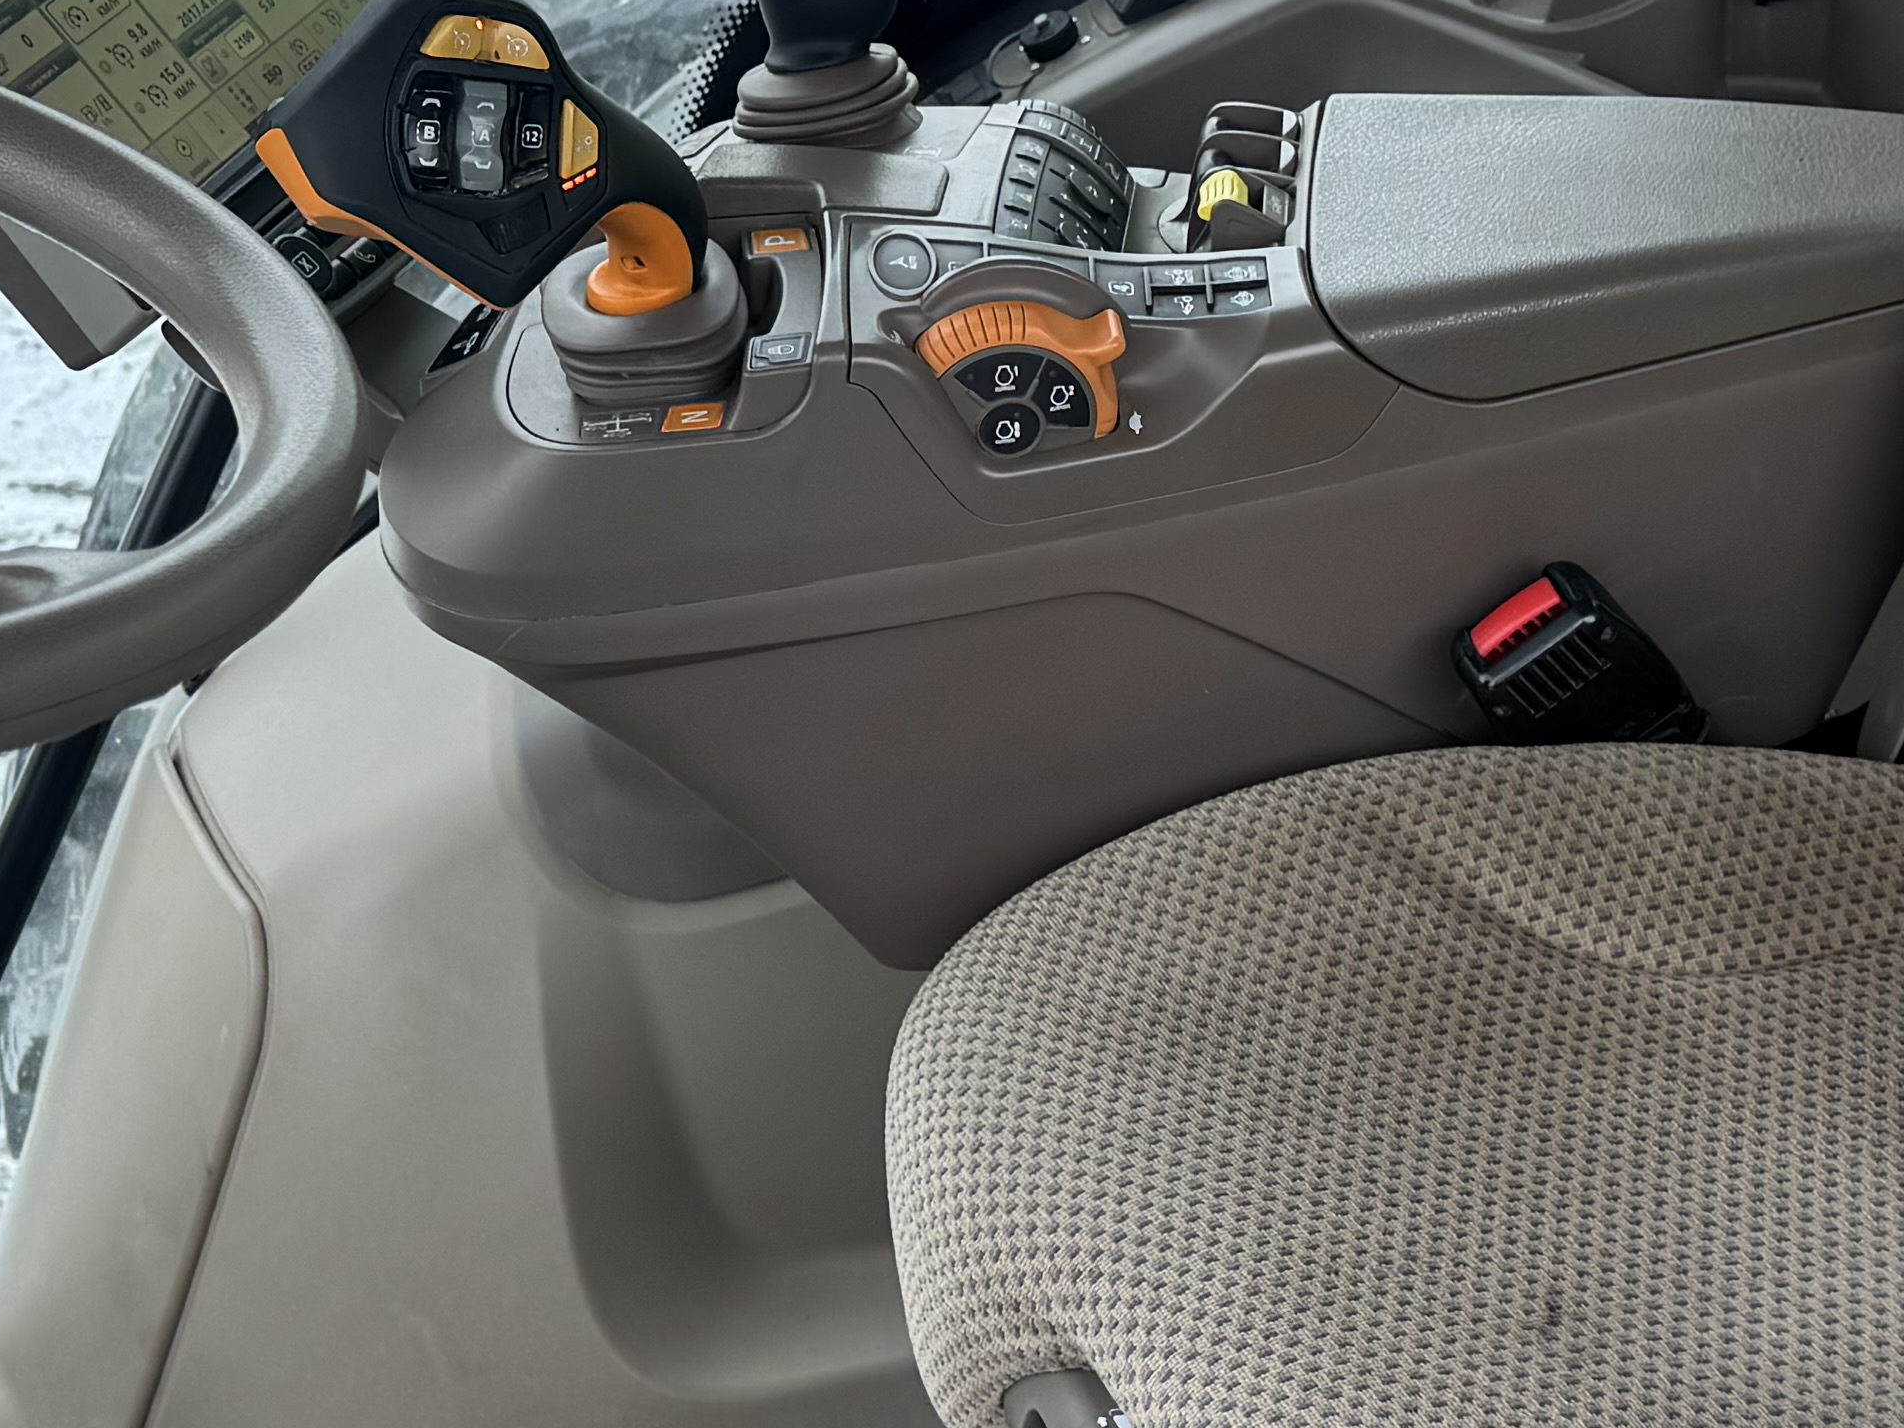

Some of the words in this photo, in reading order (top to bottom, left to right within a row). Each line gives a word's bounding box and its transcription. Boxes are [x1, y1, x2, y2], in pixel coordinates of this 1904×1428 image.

[19, 32, 35, 49] 0
[125, 21, 149, 44] 9.8
[137, 35, 164, 59] KM/H
[157, 59, 187, 87] 15.0
[262, 64, 285, 85] ISO
[171, 75, 199, 101] KM/H
[423, 125, 435, 139] B
[479, 128, 490, 141] A
[525, 131, 539, 143] 12
[765, 235, 795, 247] P
[681, 410, 709, 424] N
